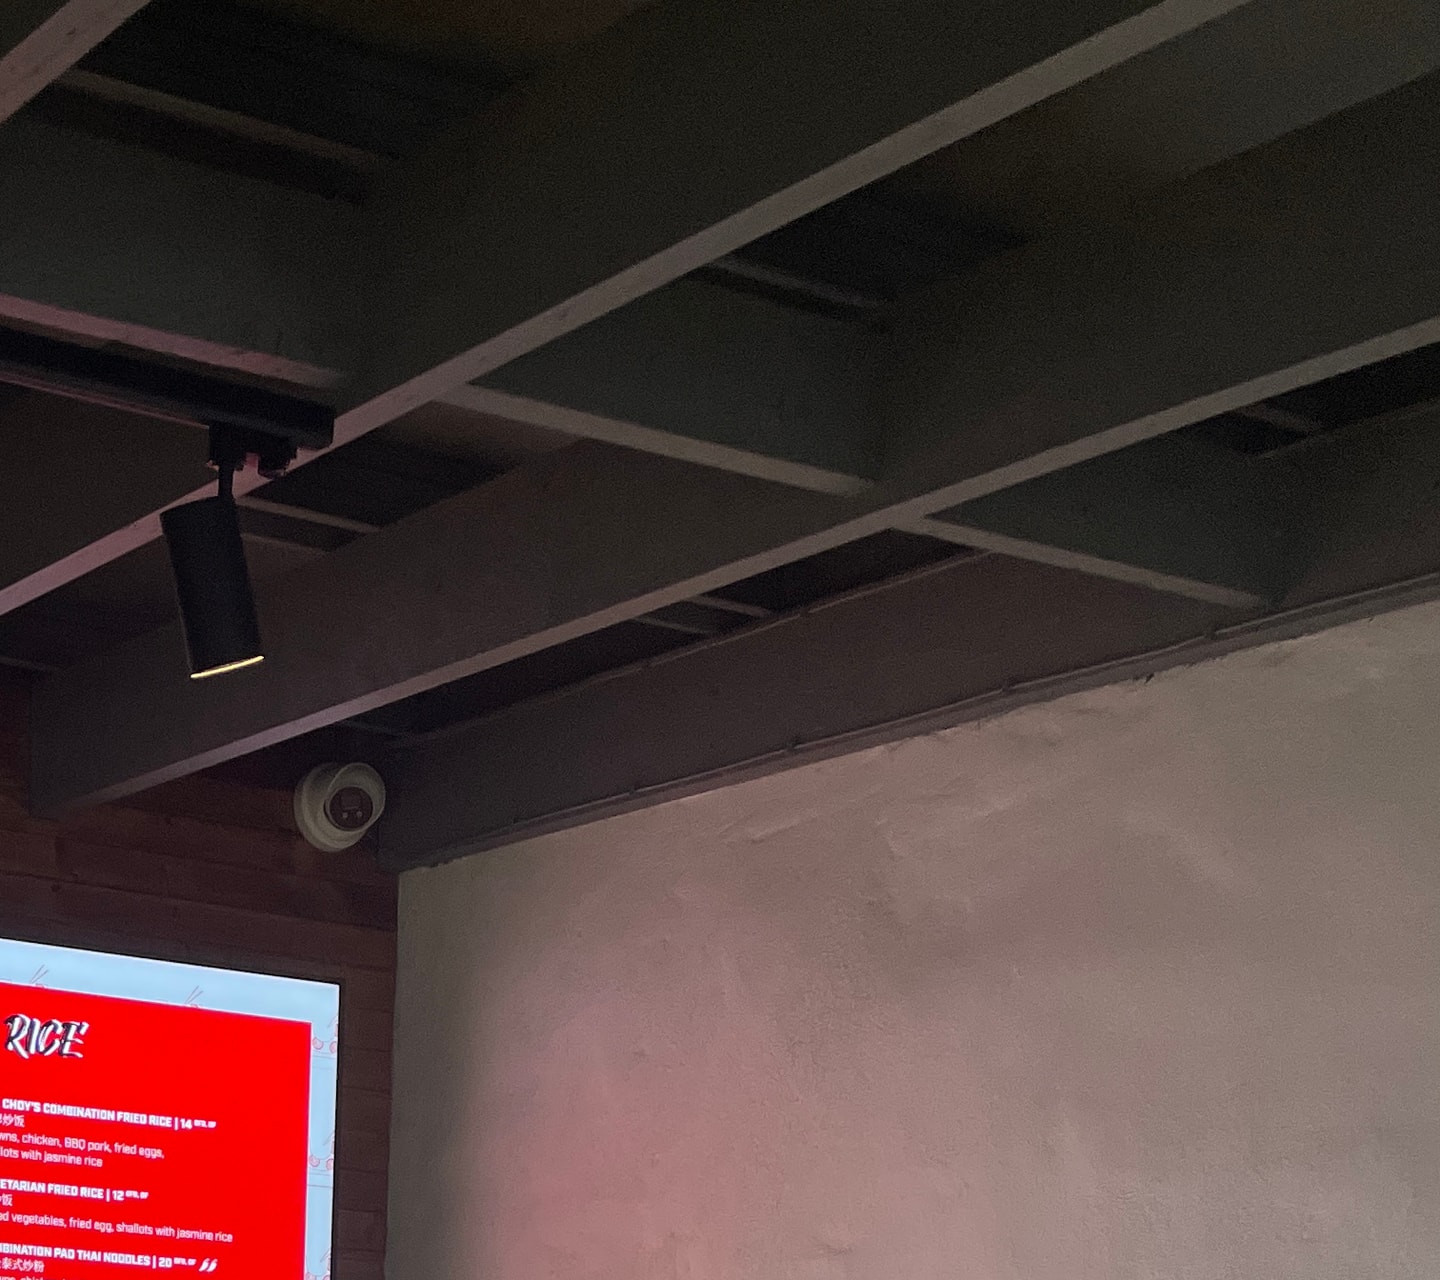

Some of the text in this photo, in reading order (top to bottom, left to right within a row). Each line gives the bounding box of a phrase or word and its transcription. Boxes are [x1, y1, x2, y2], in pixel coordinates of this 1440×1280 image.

[7, 1013, 89, 1059] RICE
[1, 1098, 41, 1113] CHOY'S
[42, 1102, 116, 1121] COMBINATION
[116, 1110, 148, 1125] FRIED
[148, 1114, 172, 1127] RICE
[179, 1118, 193, 1129] 14
[47, 1182, 79, 1196] FRIED
[79, 1186, 104, 1199] RICE
[111, 1190, 124, 1201] 12
[11, 1213, 67, 1228] vegetables,
[68, 1216, 92, 1229] fried
[115, 1221, 153, 1235] shallots
[155, 1225, 175, 1237] with
[176, 1228, 214, 1241] jasmine
[214, 1231, 233, 1242] rice
[53, 1247, 75, 1260] PAD
[76, 1249, 101, 1262] THAI
[103, 1251, 151, 1266] NOODLES
[158, 1256, 172, 1268] 20
